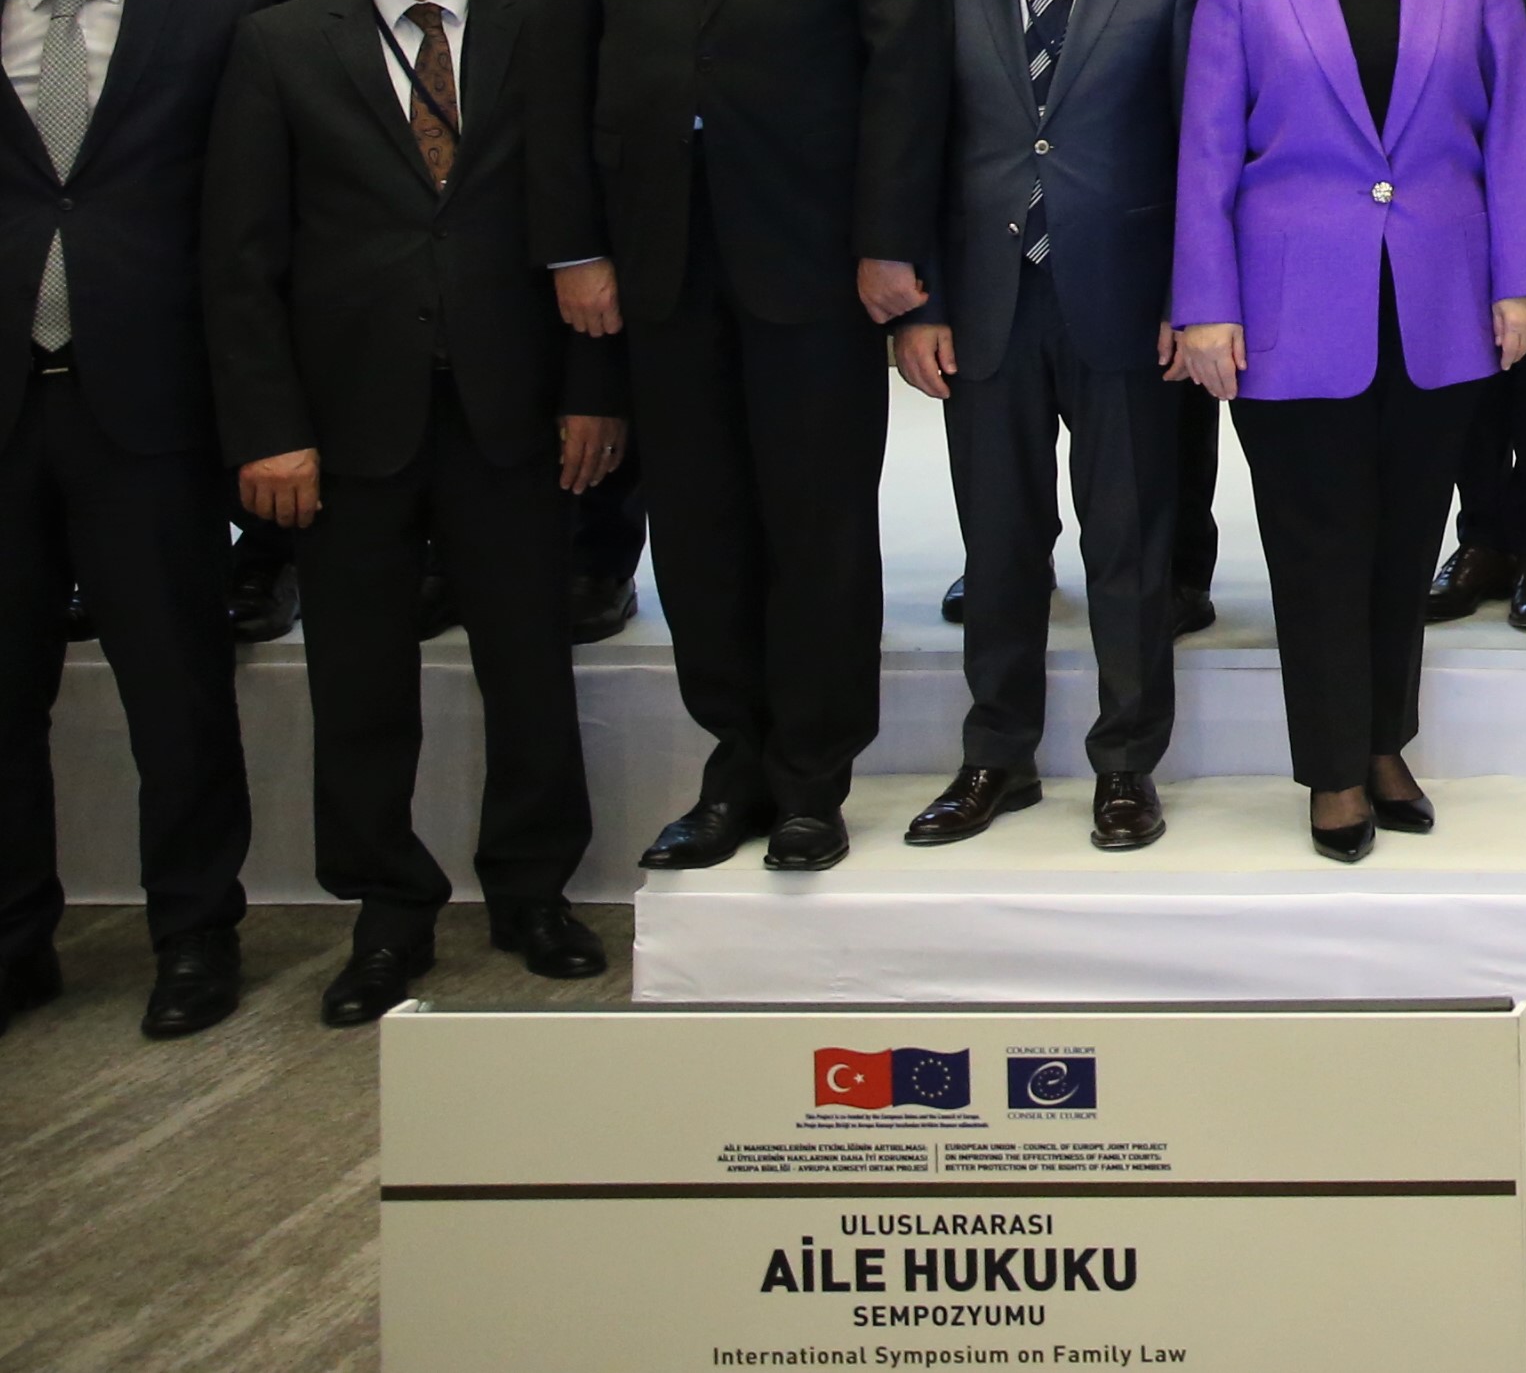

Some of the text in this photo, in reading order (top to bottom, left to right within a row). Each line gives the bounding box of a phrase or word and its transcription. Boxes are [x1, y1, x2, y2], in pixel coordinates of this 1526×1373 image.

[842, 1215, 1052, 1235] ULUSLARARASI
[761, 1236, 1137, 1293] AİLE HUKUKU
[854, 1305, 1044, 1326] SEMPOZYUMU
[714, 1345, 1186, 1368] International Symposium on Family Law
